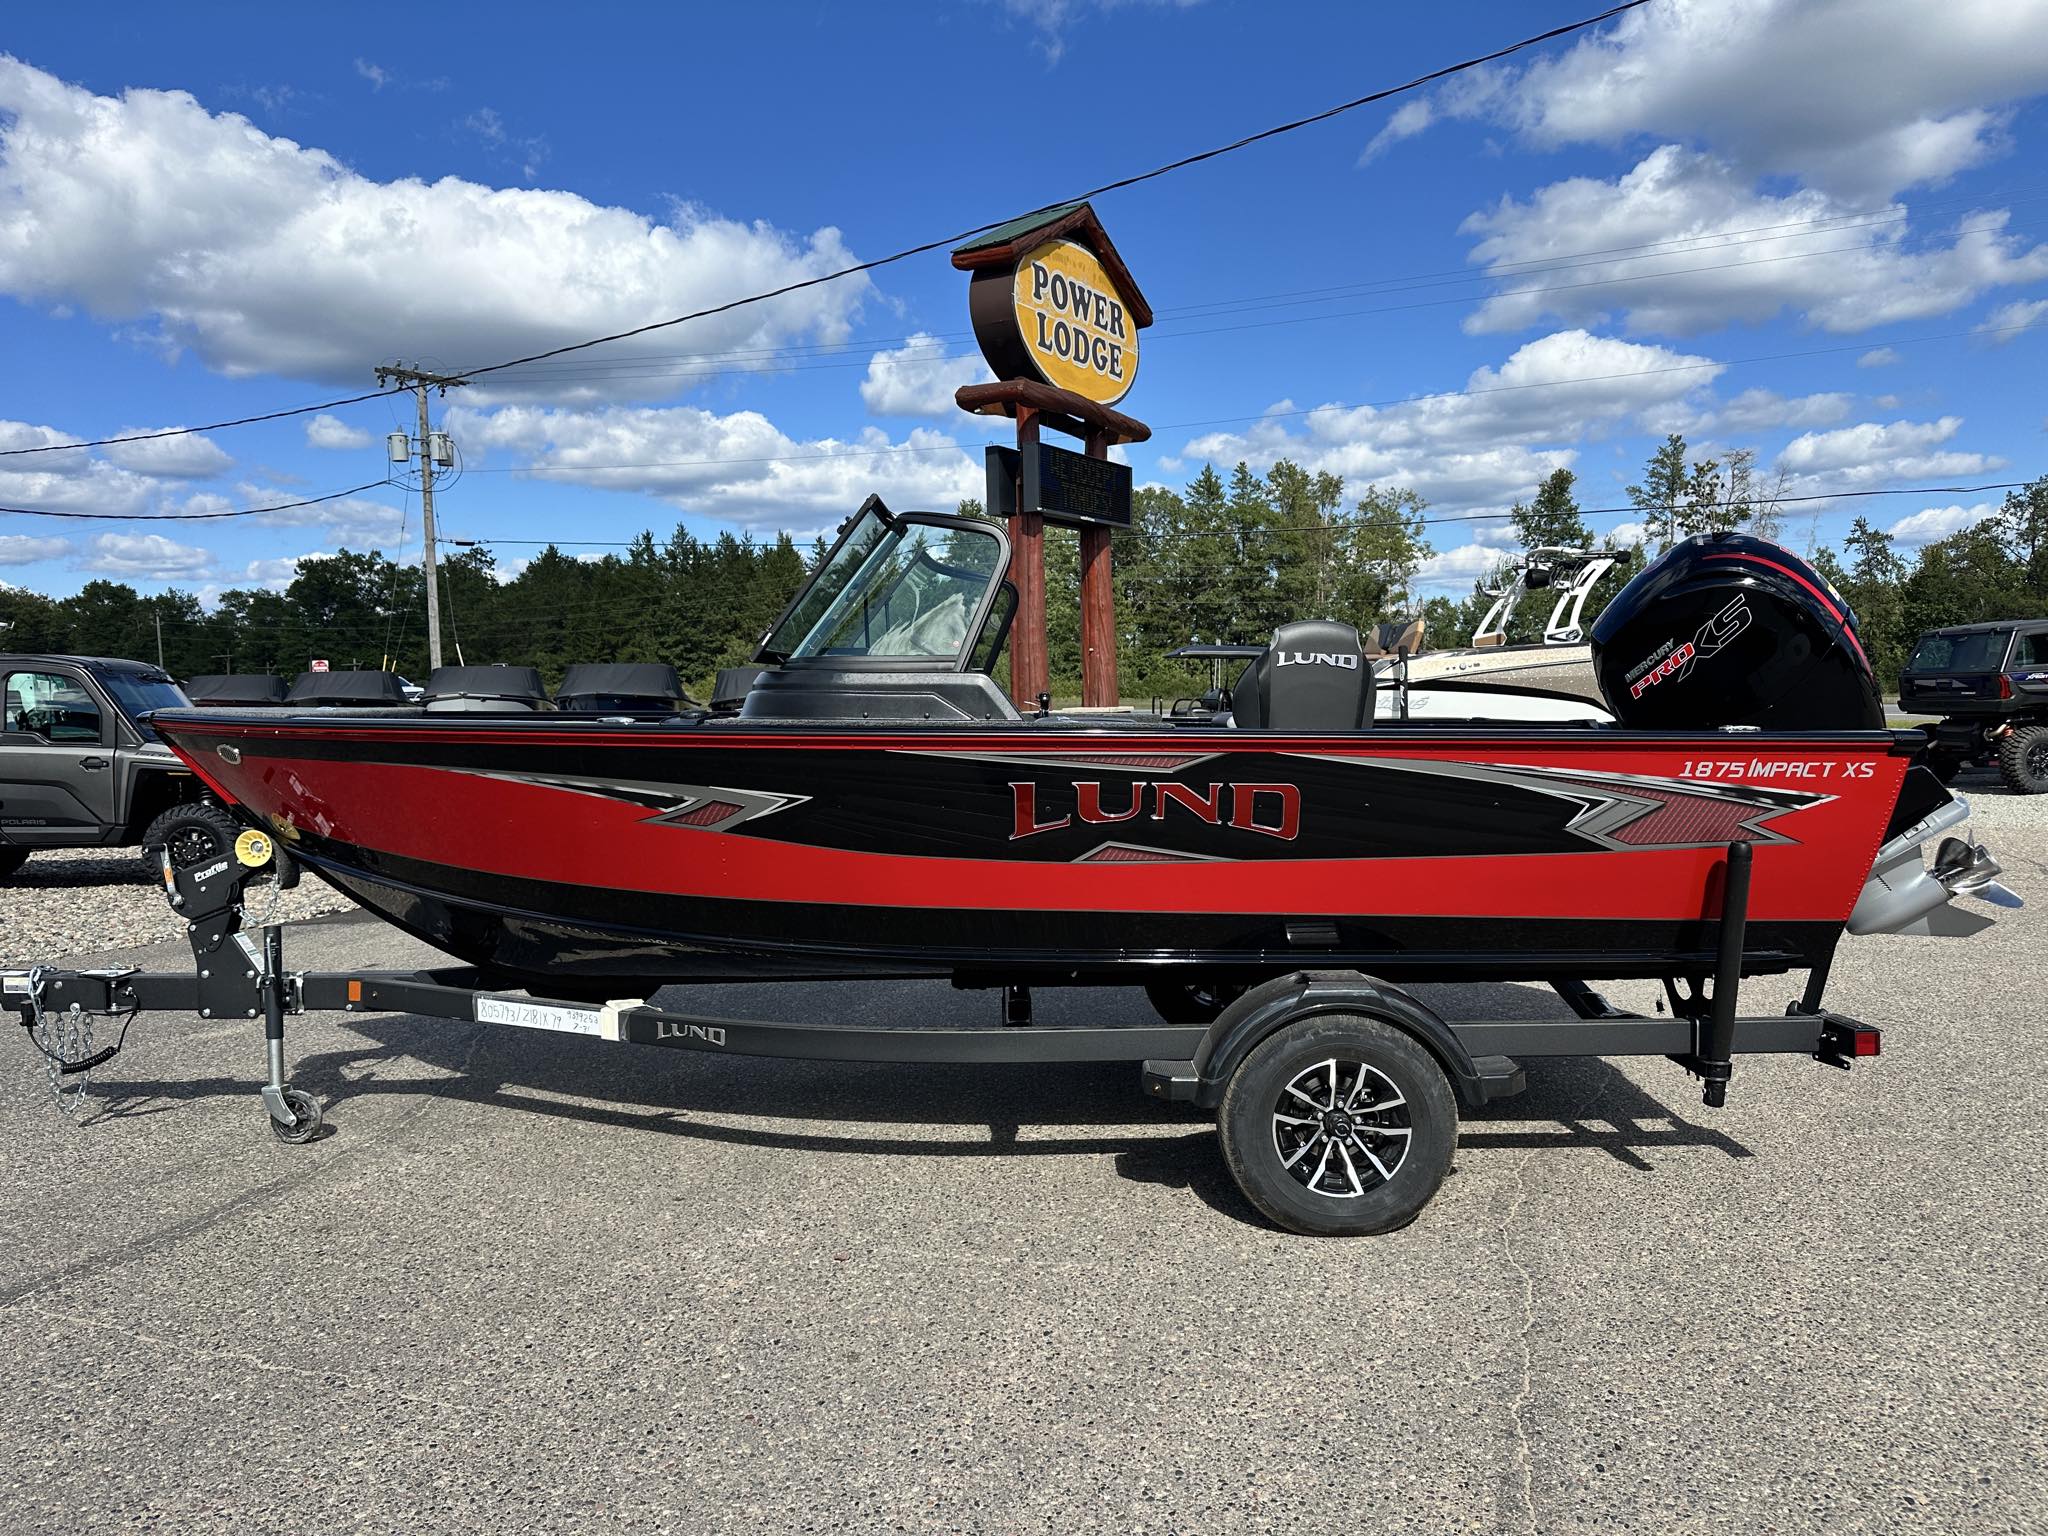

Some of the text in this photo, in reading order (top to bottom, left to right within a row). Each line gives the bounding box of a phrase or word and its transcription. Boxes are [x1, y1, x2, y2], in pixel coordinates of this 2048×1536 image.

[1031, 261, 1126, 339] POWER
[1036, 311, 1123, 380] LODGE
[1276, 651, 1358, 670] LUND
[1624, 637, 1675, 683] MERCURY
[1630, 642, 1695, 699] PRO
[1678, 757, 1877, 778] 1875 IMPACT XS
[1008, 781, 1300, 841] LUND
[656, 1021, 726, 1047] LUND
